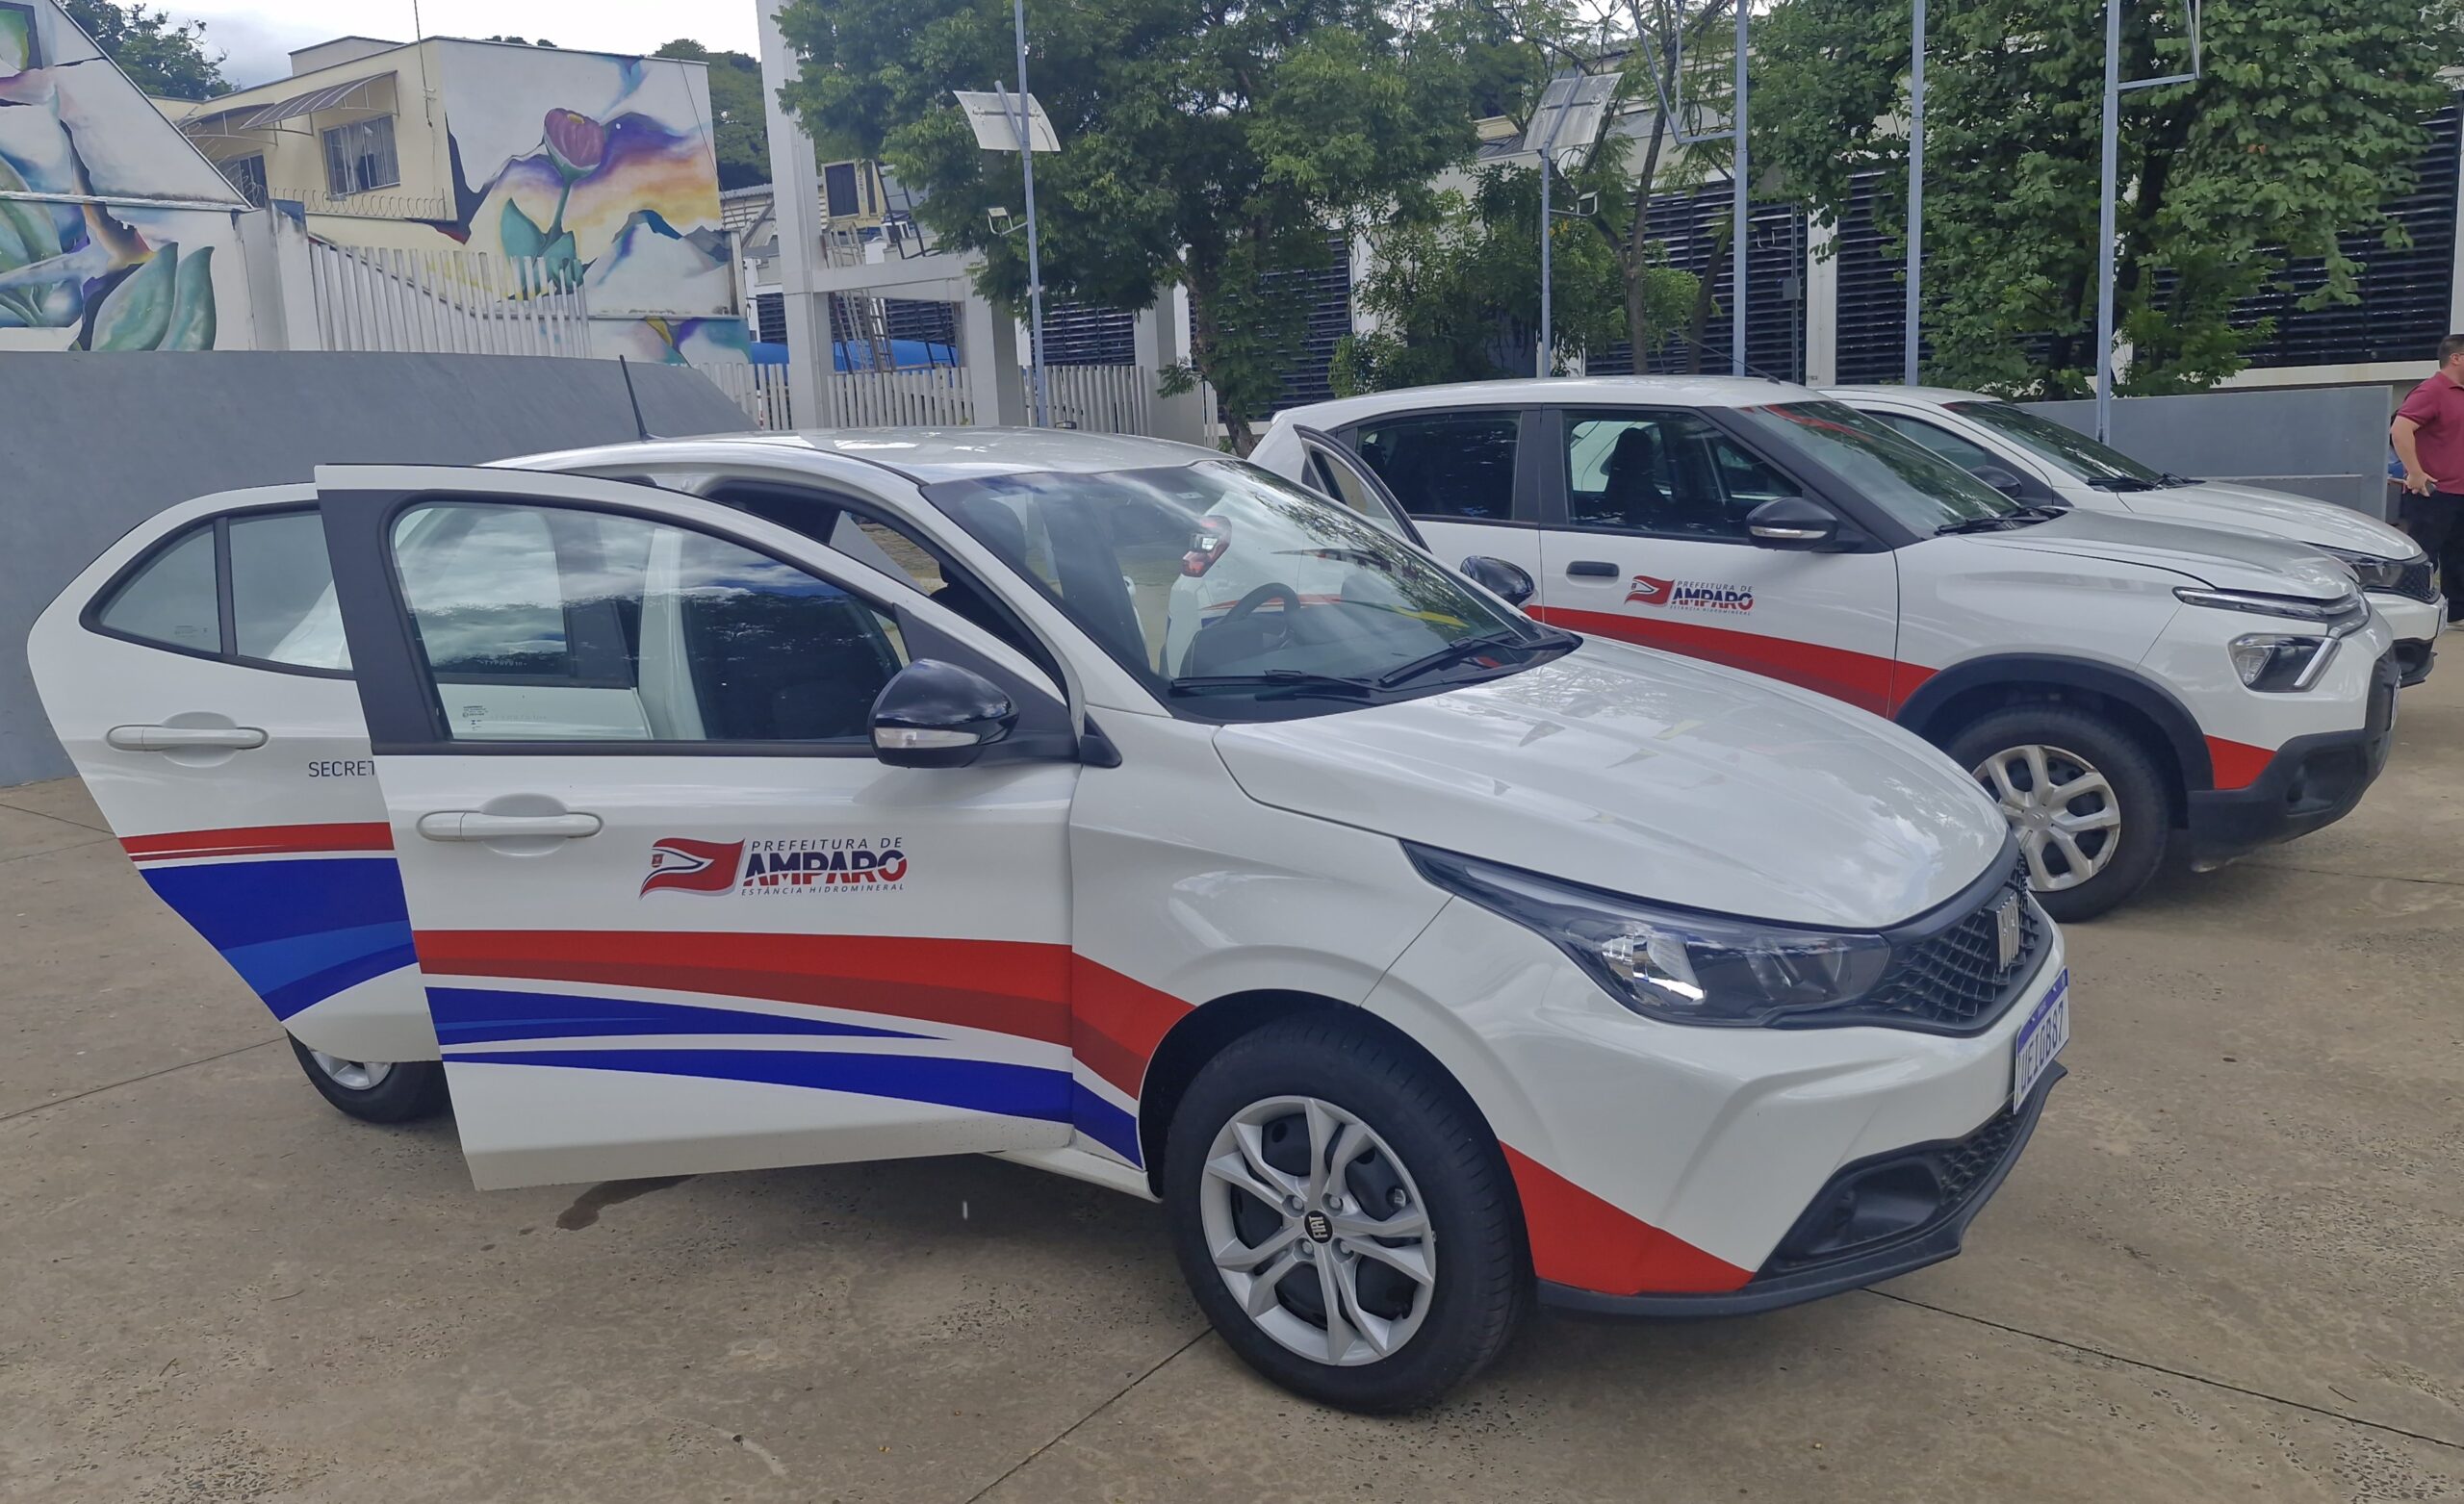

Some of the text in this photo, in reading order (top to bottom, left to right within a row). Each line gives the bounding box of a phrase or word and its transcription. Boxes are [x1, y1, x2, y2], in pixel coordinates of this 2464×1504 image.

[1677, 580, 1734, 591] PREFEITURA
[1672, 588, 1754, 611] AMPARO
[308, 760, 375, 777] SECRET
[751, 837, 903, 852] PREFEITURA DE
[742, 850, 908, 887] AMPARO
[741, 882, 905, 897] ESTÂNCIA HIDROMINERAL
[1309, 1215, 1328, 1238] FIAT
